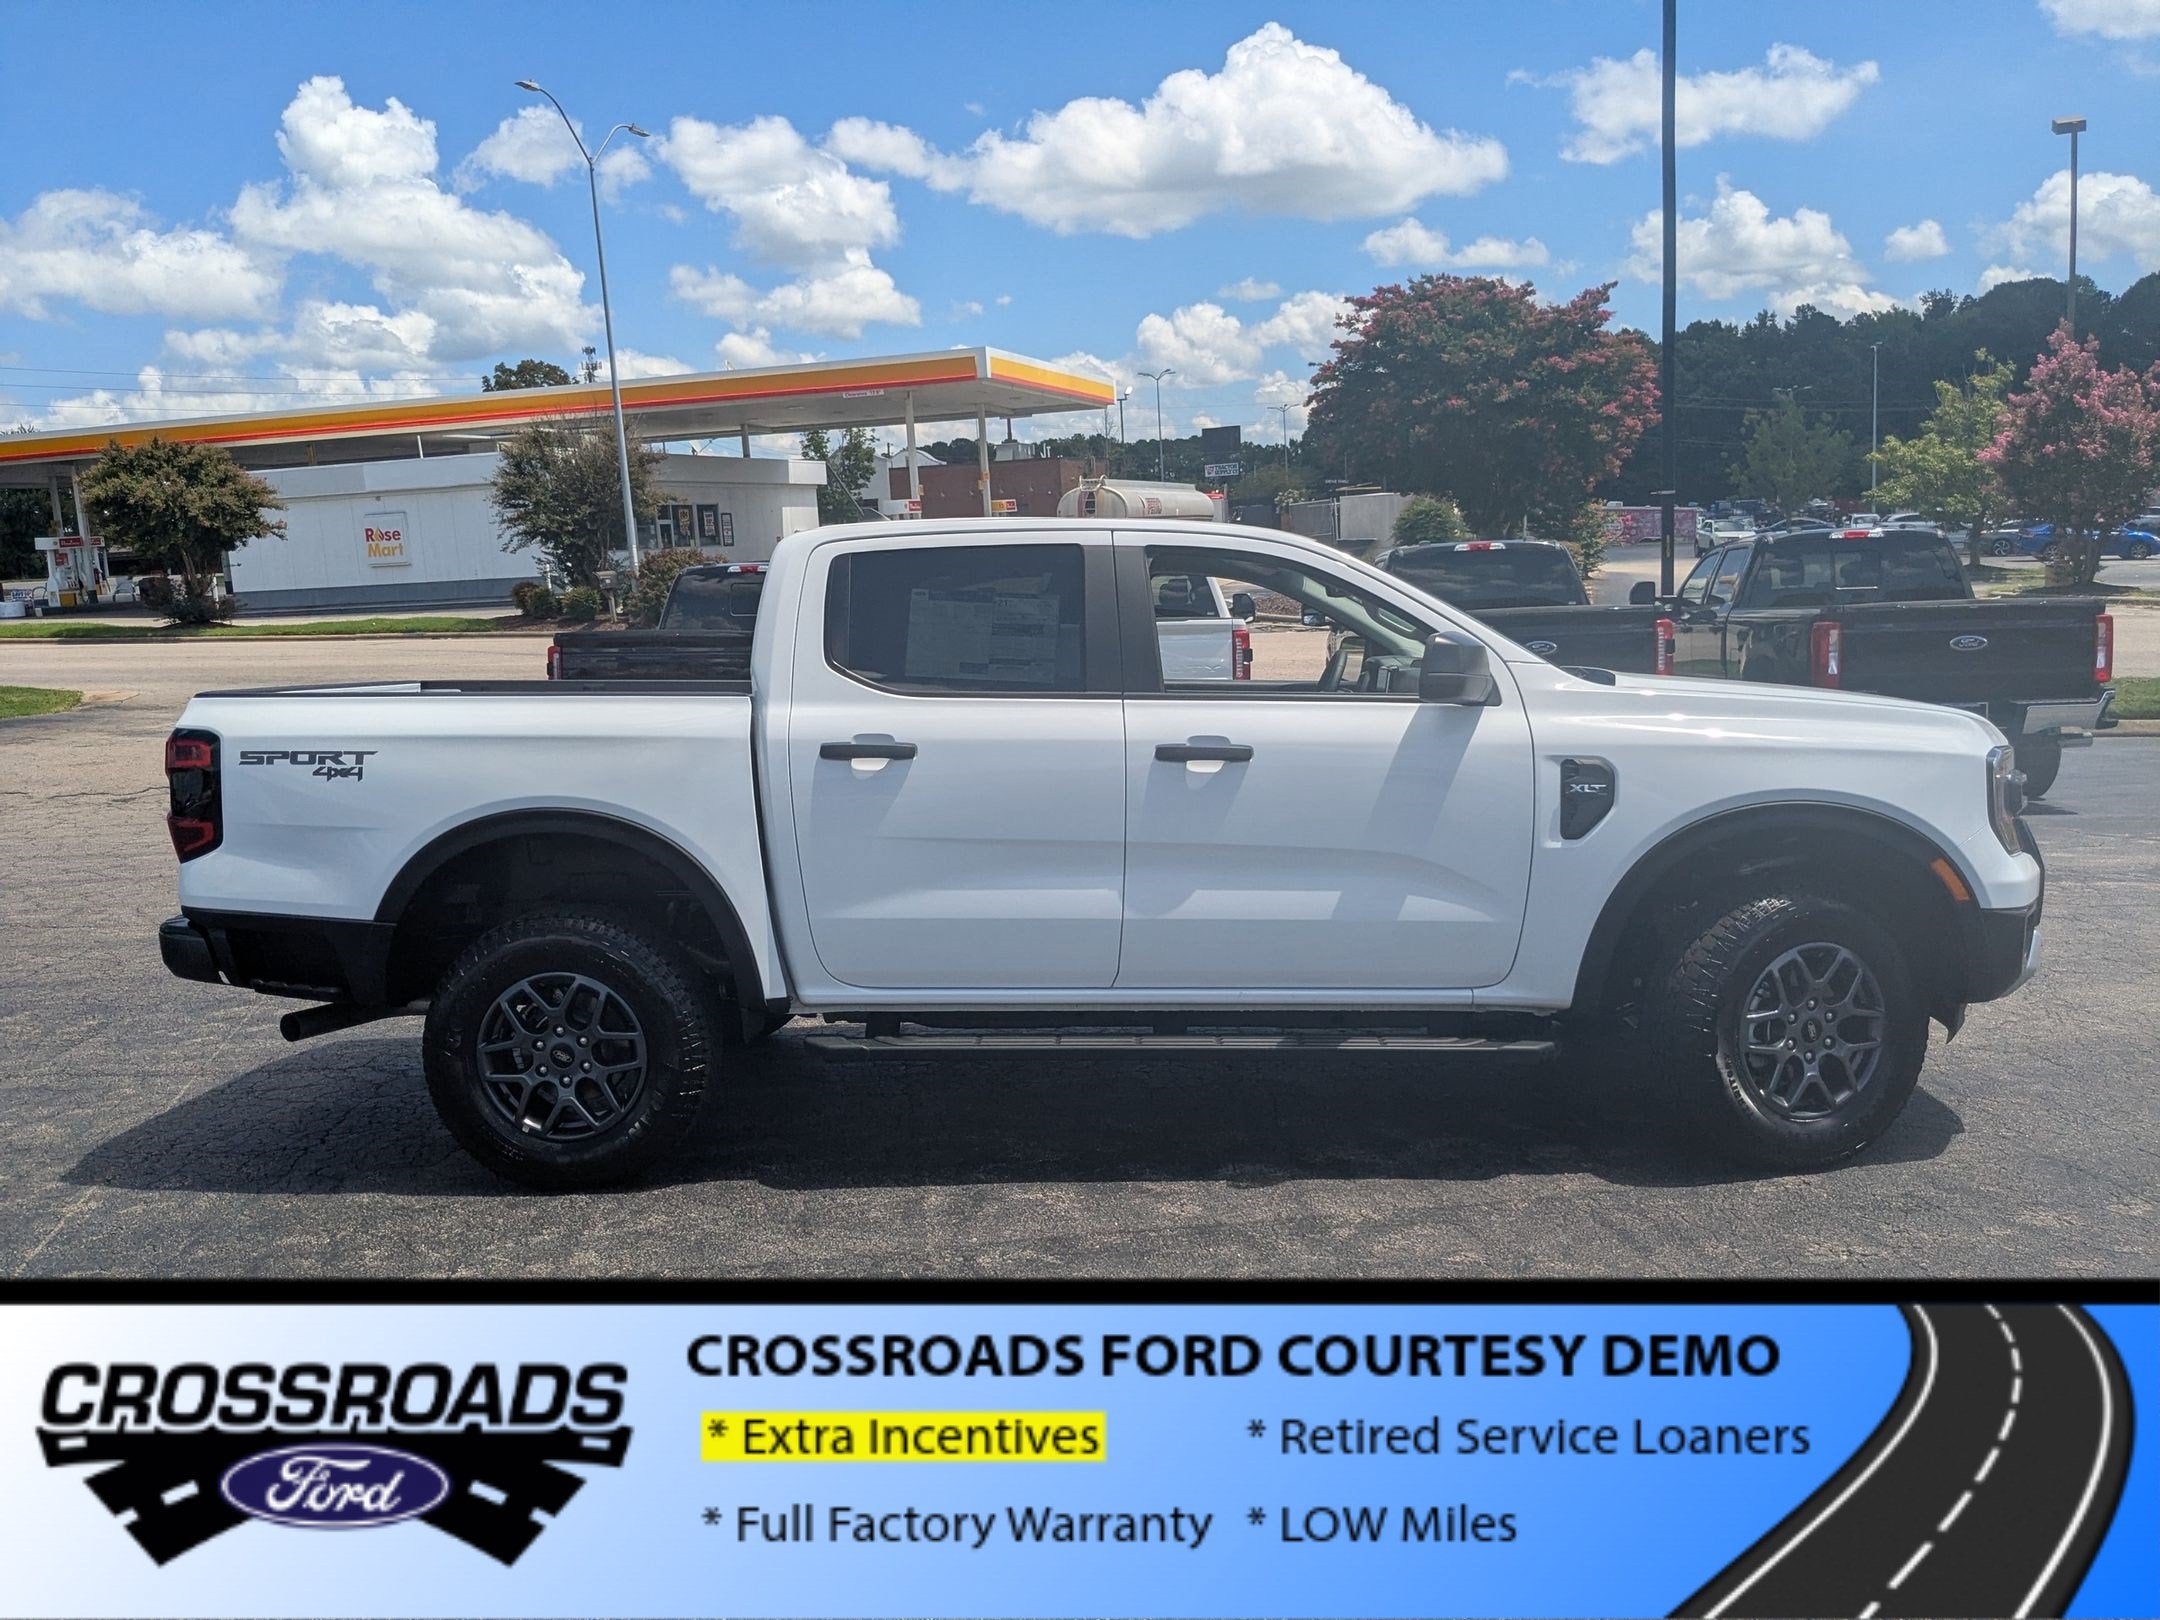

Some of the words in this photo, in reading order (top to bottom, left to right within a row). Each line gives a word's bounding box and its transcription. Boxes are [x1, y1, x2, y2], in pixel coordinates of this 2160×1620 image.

[364, 527, 401, 542] Rose
[368, 543, 404, 557] Mart
[239, 751, 379, 765] SPORT
[312, 766, 363, 782] 4x4
[1570, 784, 1608, 795] XLT
